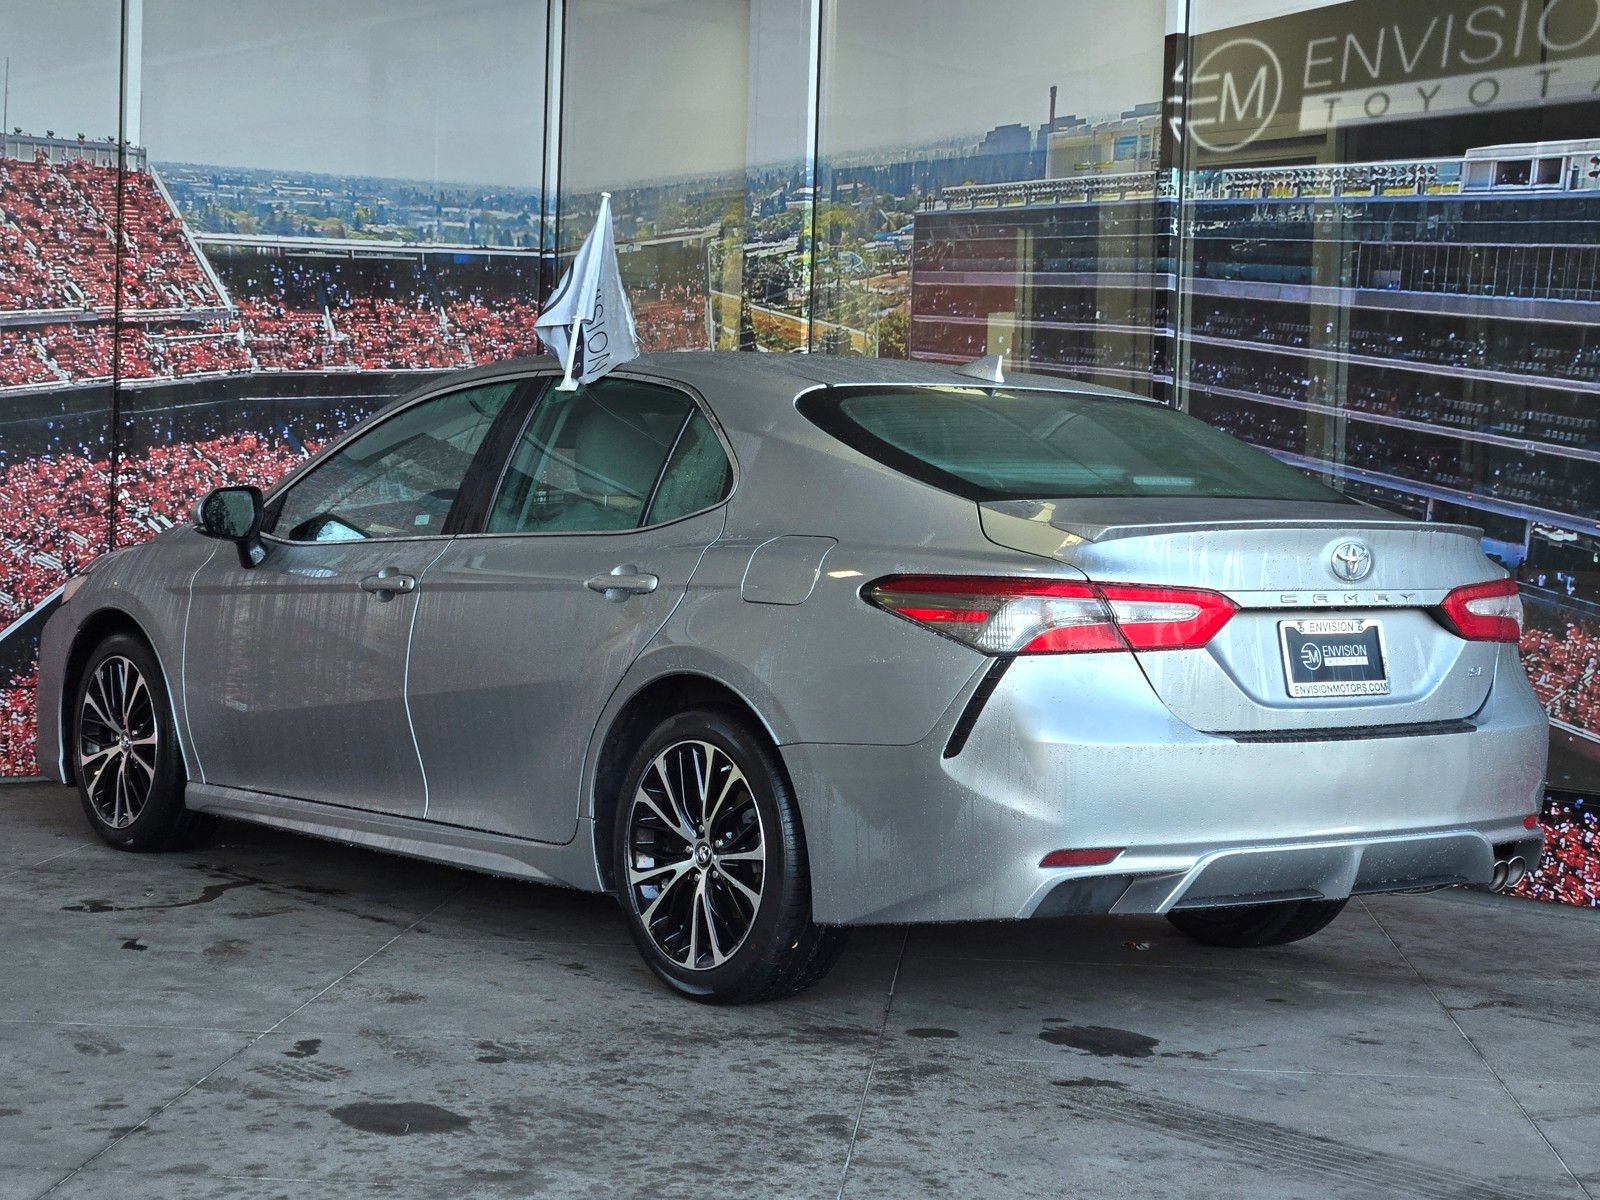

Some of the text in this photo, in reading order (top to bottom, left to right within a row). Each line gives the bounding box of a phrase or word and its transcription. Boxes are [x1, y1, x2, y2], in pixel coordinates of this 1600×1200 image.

[1324, 68, 1600, 123] TOYOT
[1280, 593, 1415, 604] CAMRY
[1309, 622, 1354, 633] ENVISION
[1322, 644, 1367, 657] ENVISION
[1294, 682, 1387, 695] ENVISIONMOTORS.COM
